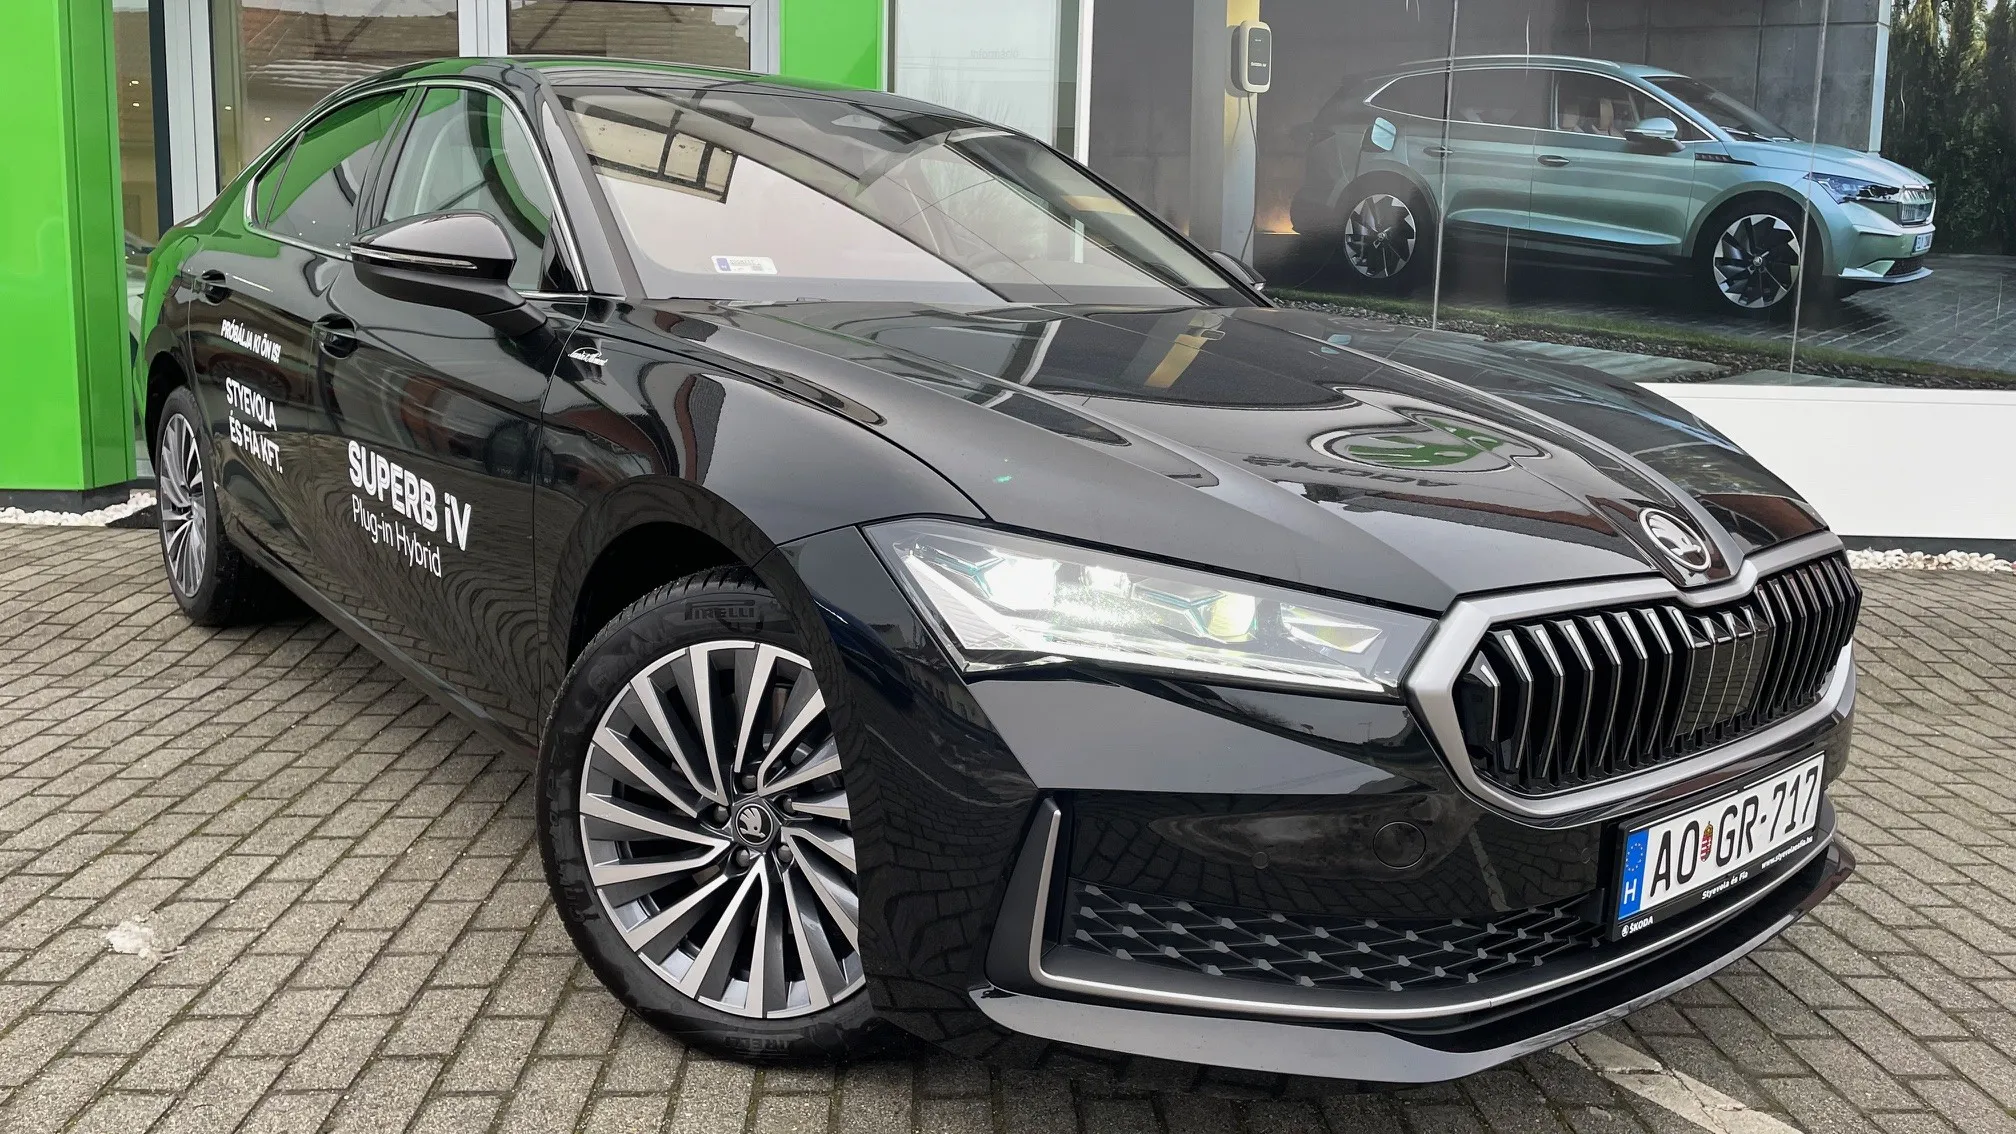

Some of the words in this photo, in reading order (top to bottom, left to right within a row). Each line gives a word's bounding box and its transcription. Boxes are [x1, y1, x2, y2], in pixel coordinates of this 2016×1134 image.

[221, 318, 254, 351] PRÓBÁLJA
[253, 333, 262, 354] KI
[261, 333, 272, 360] ÖN
[271, 342, 281, 364] IS!
[225, 376, 278, 432] STYEVOLA
[228, 409, 243, 447] ÉS
[242, 424, 261, 460] FIA
[260, 434, 283, 474] KFT.
[348, 440, 438, 532] SUPERB
[444, 492, 472, 552] iV
[352, 493, 394, 547] Plug-in
[395, 520, 442, 578] Hybrid
[684, 599, 756, 620] PIRELLI
[1650, 820, 1699, 898] AO
[1715, 765, 1819, 867] GR-717
[1623, 878, 1638, 905] H
[1701, 880, 1730, 900] Styevola
[1629, 915, 1653, 934] ŠKODA
